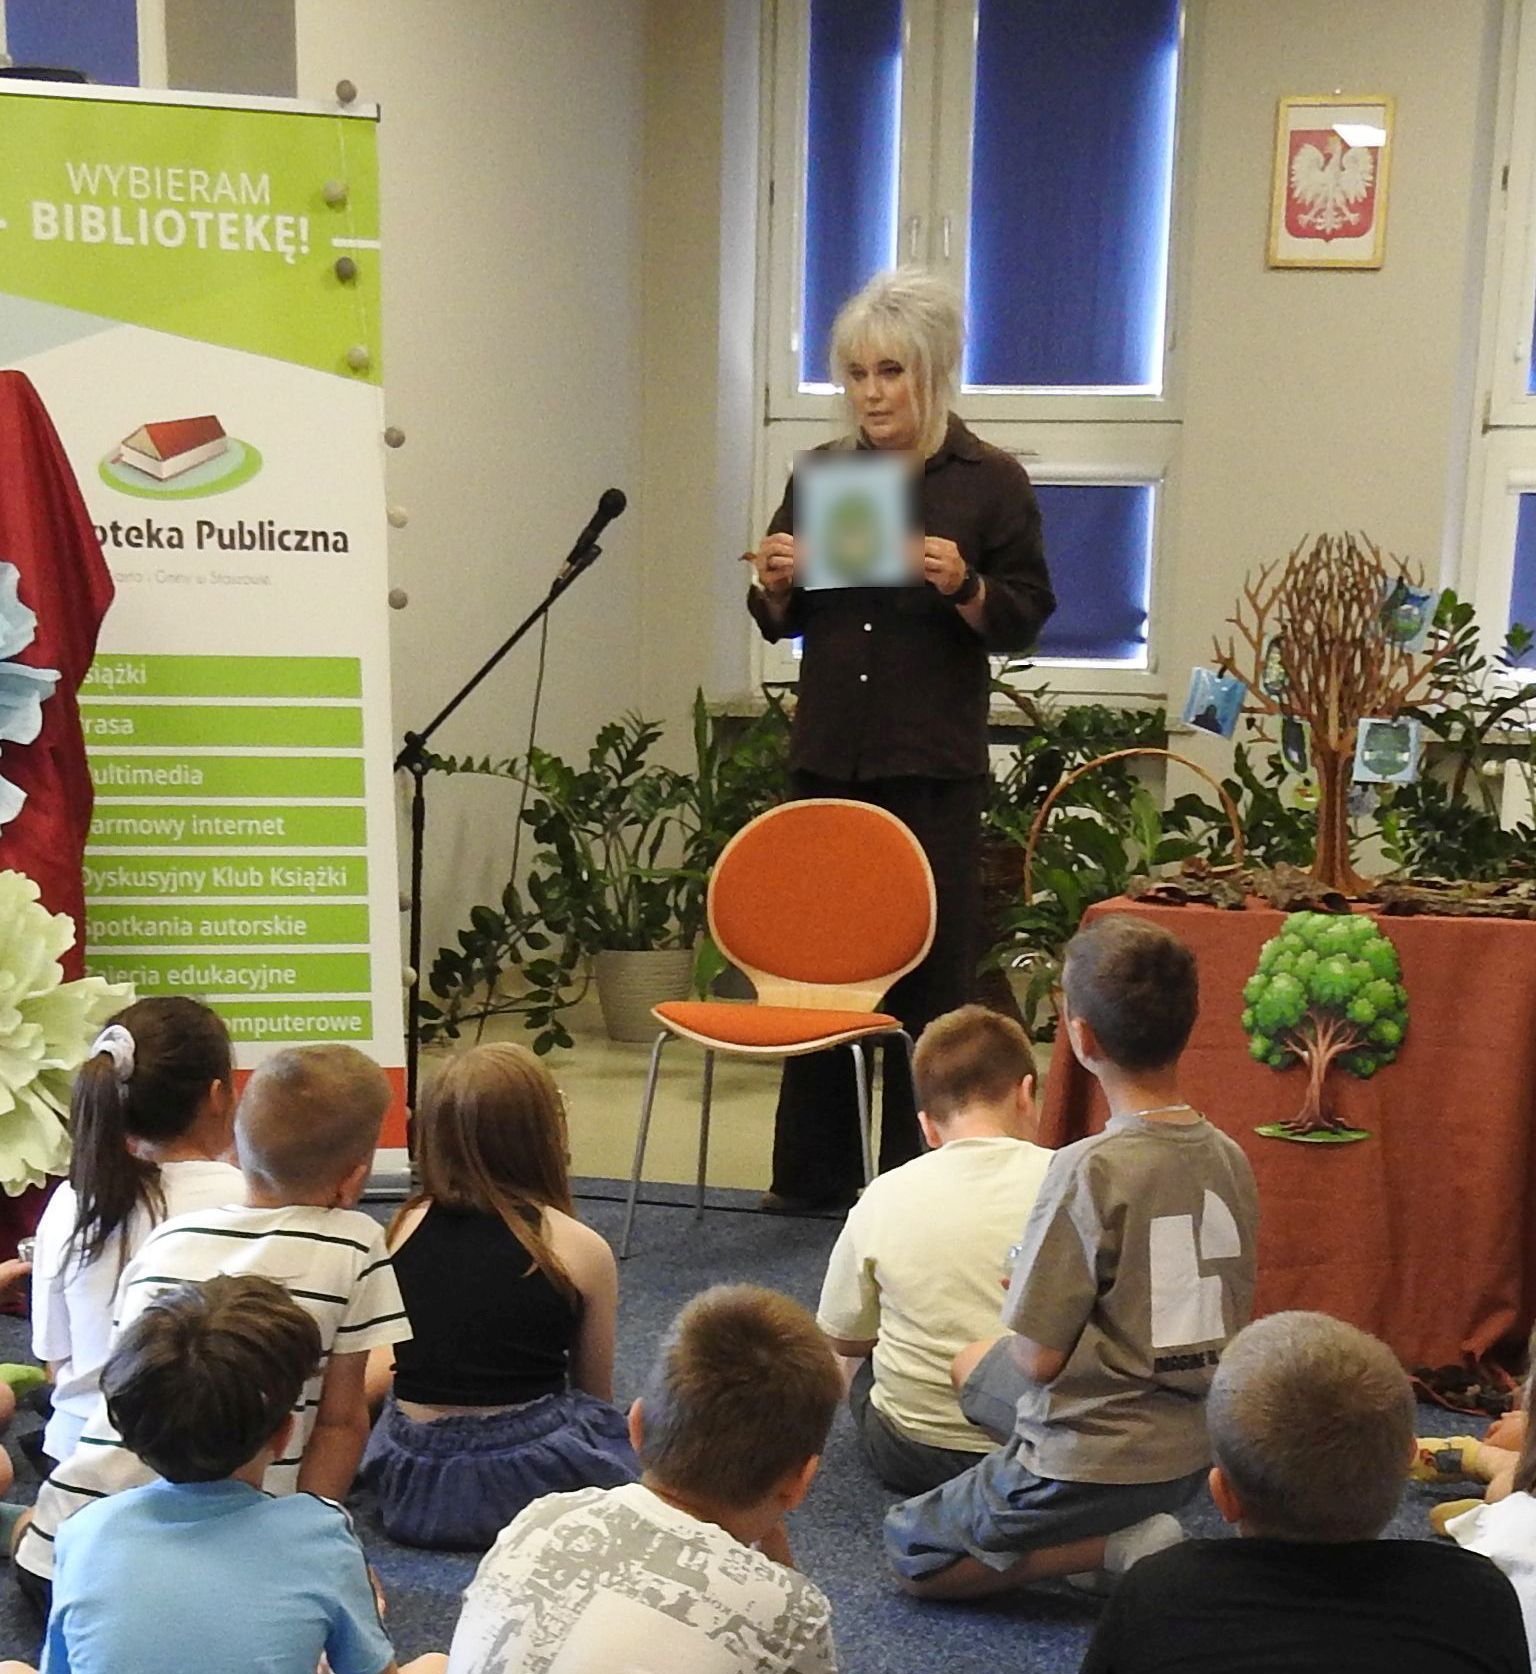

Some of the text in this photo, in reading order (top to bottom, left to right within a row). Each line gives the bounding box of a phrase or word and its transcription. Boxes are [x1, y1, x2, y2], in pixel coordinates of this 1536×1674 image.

[66, 162, 271, 206] WYBIERAM
[31, 201, 311, 265] BIBLIOTEKĘ!
[94, 519, 349, 553] oteka Publiczna
[84, 663, 147, 689] siążki
[83, 717, 134, 735] rasa
[93, 764, 204, 786] ultimedia
[90, 815, 285, 841] armowy internet
[214, 867, 263, 887] Klub
[270, 867, 347, 893] Książki
[200, 915, 307, 936] autorskie
[167, 965, 297, 991] edukacyjne
[223, 1015, 362, 1038] omputerowe
